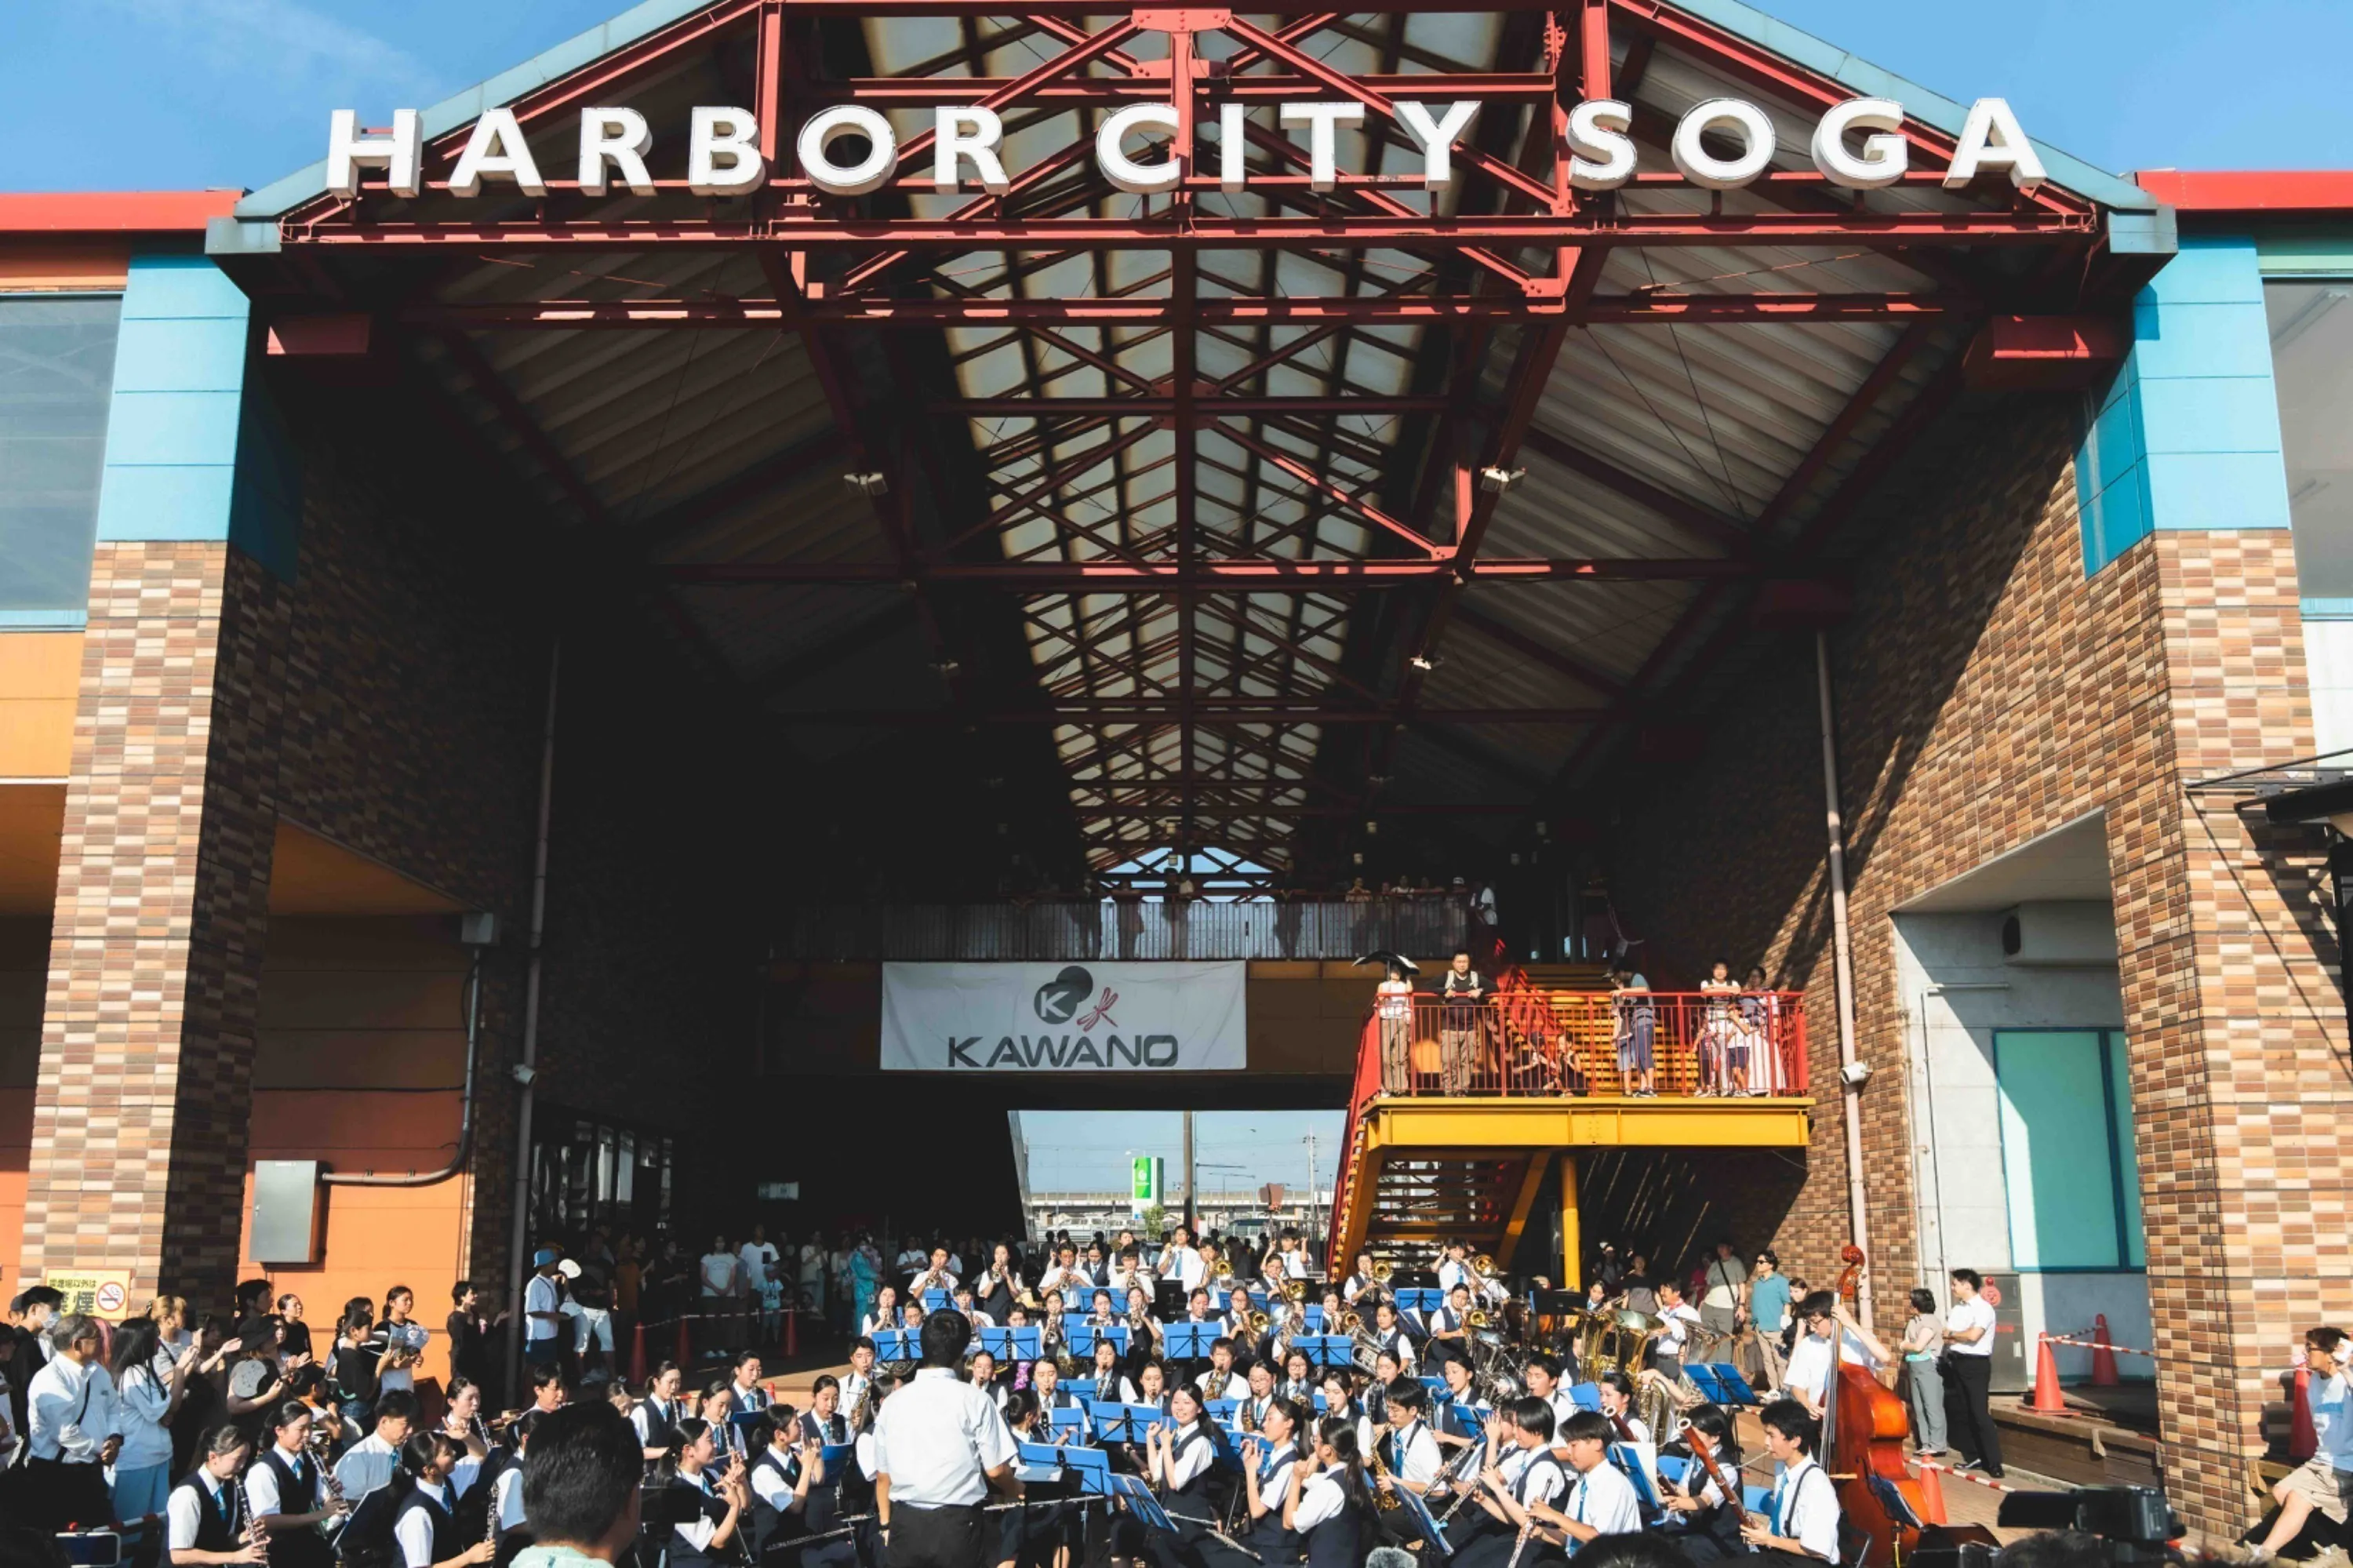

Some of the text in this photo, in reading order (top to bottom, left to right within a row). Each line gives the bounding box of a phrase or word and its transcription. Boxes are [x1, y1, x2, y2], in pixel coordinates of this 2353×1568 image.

[326, 97, 2048, 198] HARBOR CITY SOGA
[1041, 991, 1068, 1018] K
[948, 1035, 1179, 1068] KAWANO
